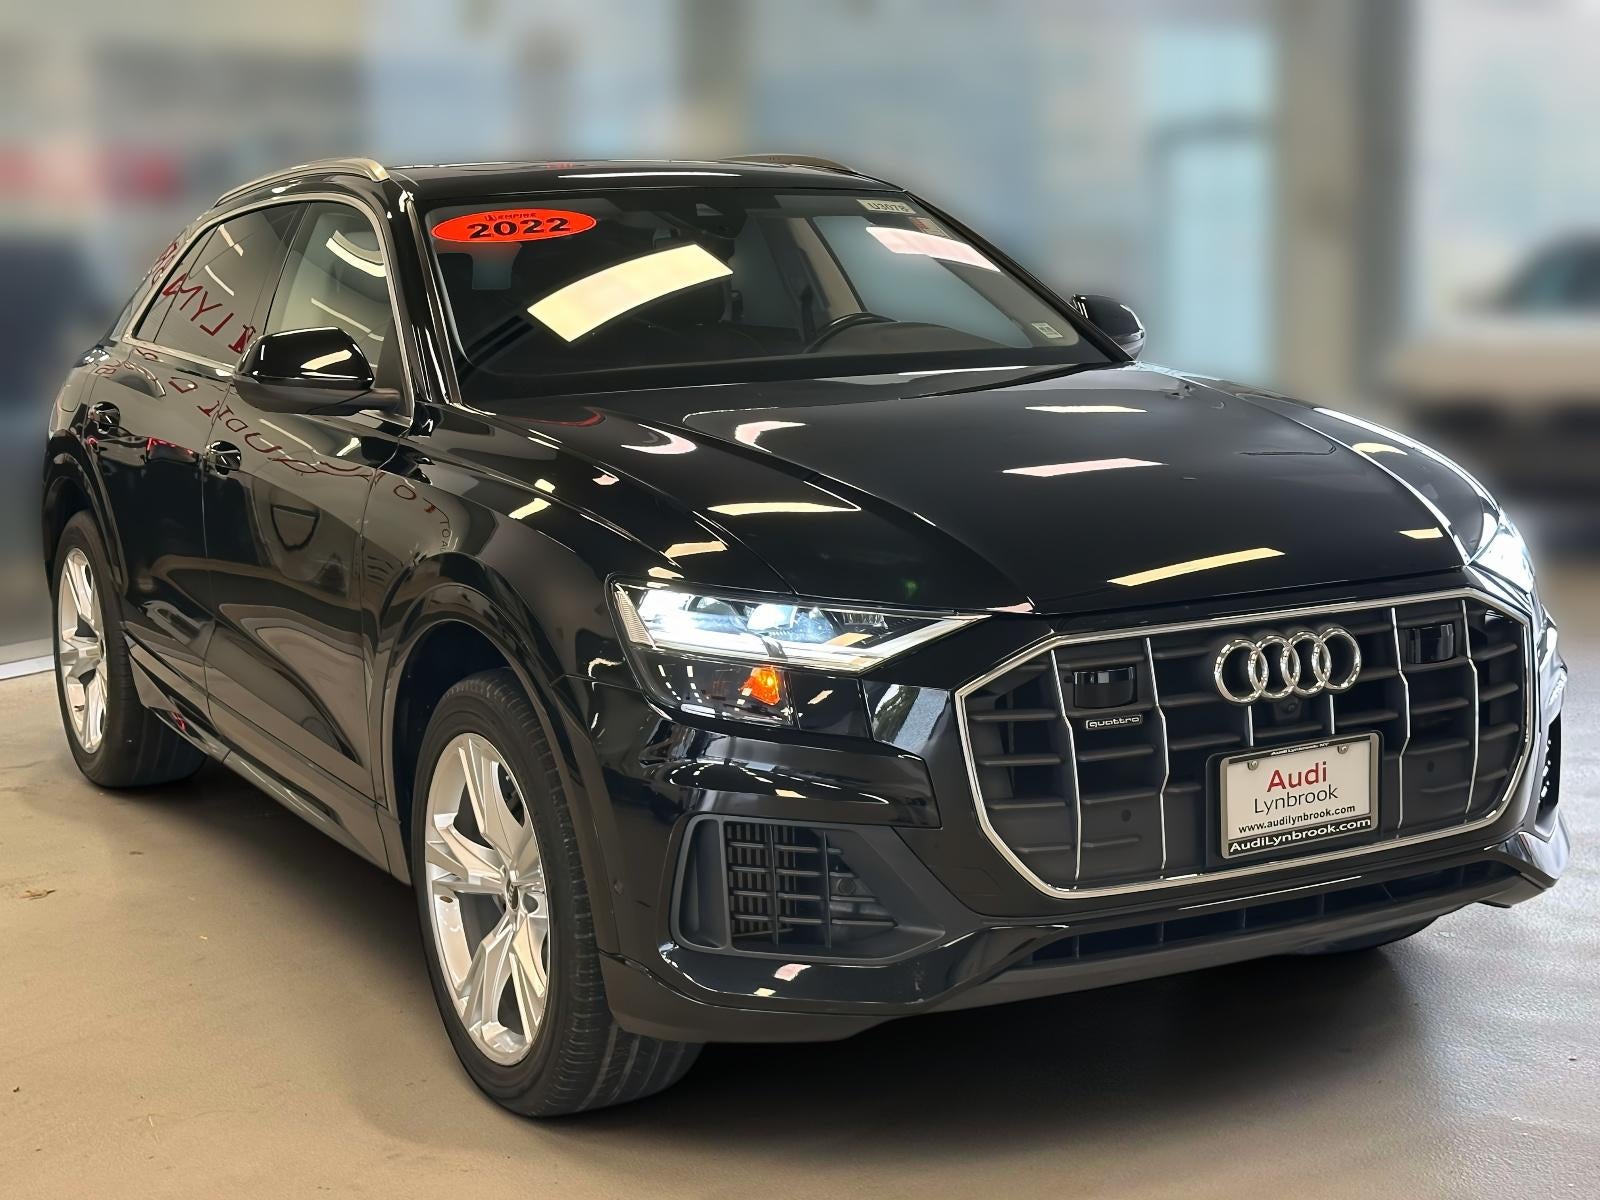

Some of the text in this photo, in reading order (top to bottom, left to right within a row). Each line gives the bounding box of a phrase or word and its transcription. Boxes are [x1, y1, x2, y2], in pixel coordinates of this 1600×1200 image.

[466, 217, 571, 239] 2022
[1089, 717, 1140, 728] quattro
[1266, 760, 1328, 793] Audi
[1254, 784, 1339, 816] Lynbrook
[1238, 805, 1356, 834] www.audilynbrook.com
[1229, 819, 1372, 853] AudiLynbrook.com
